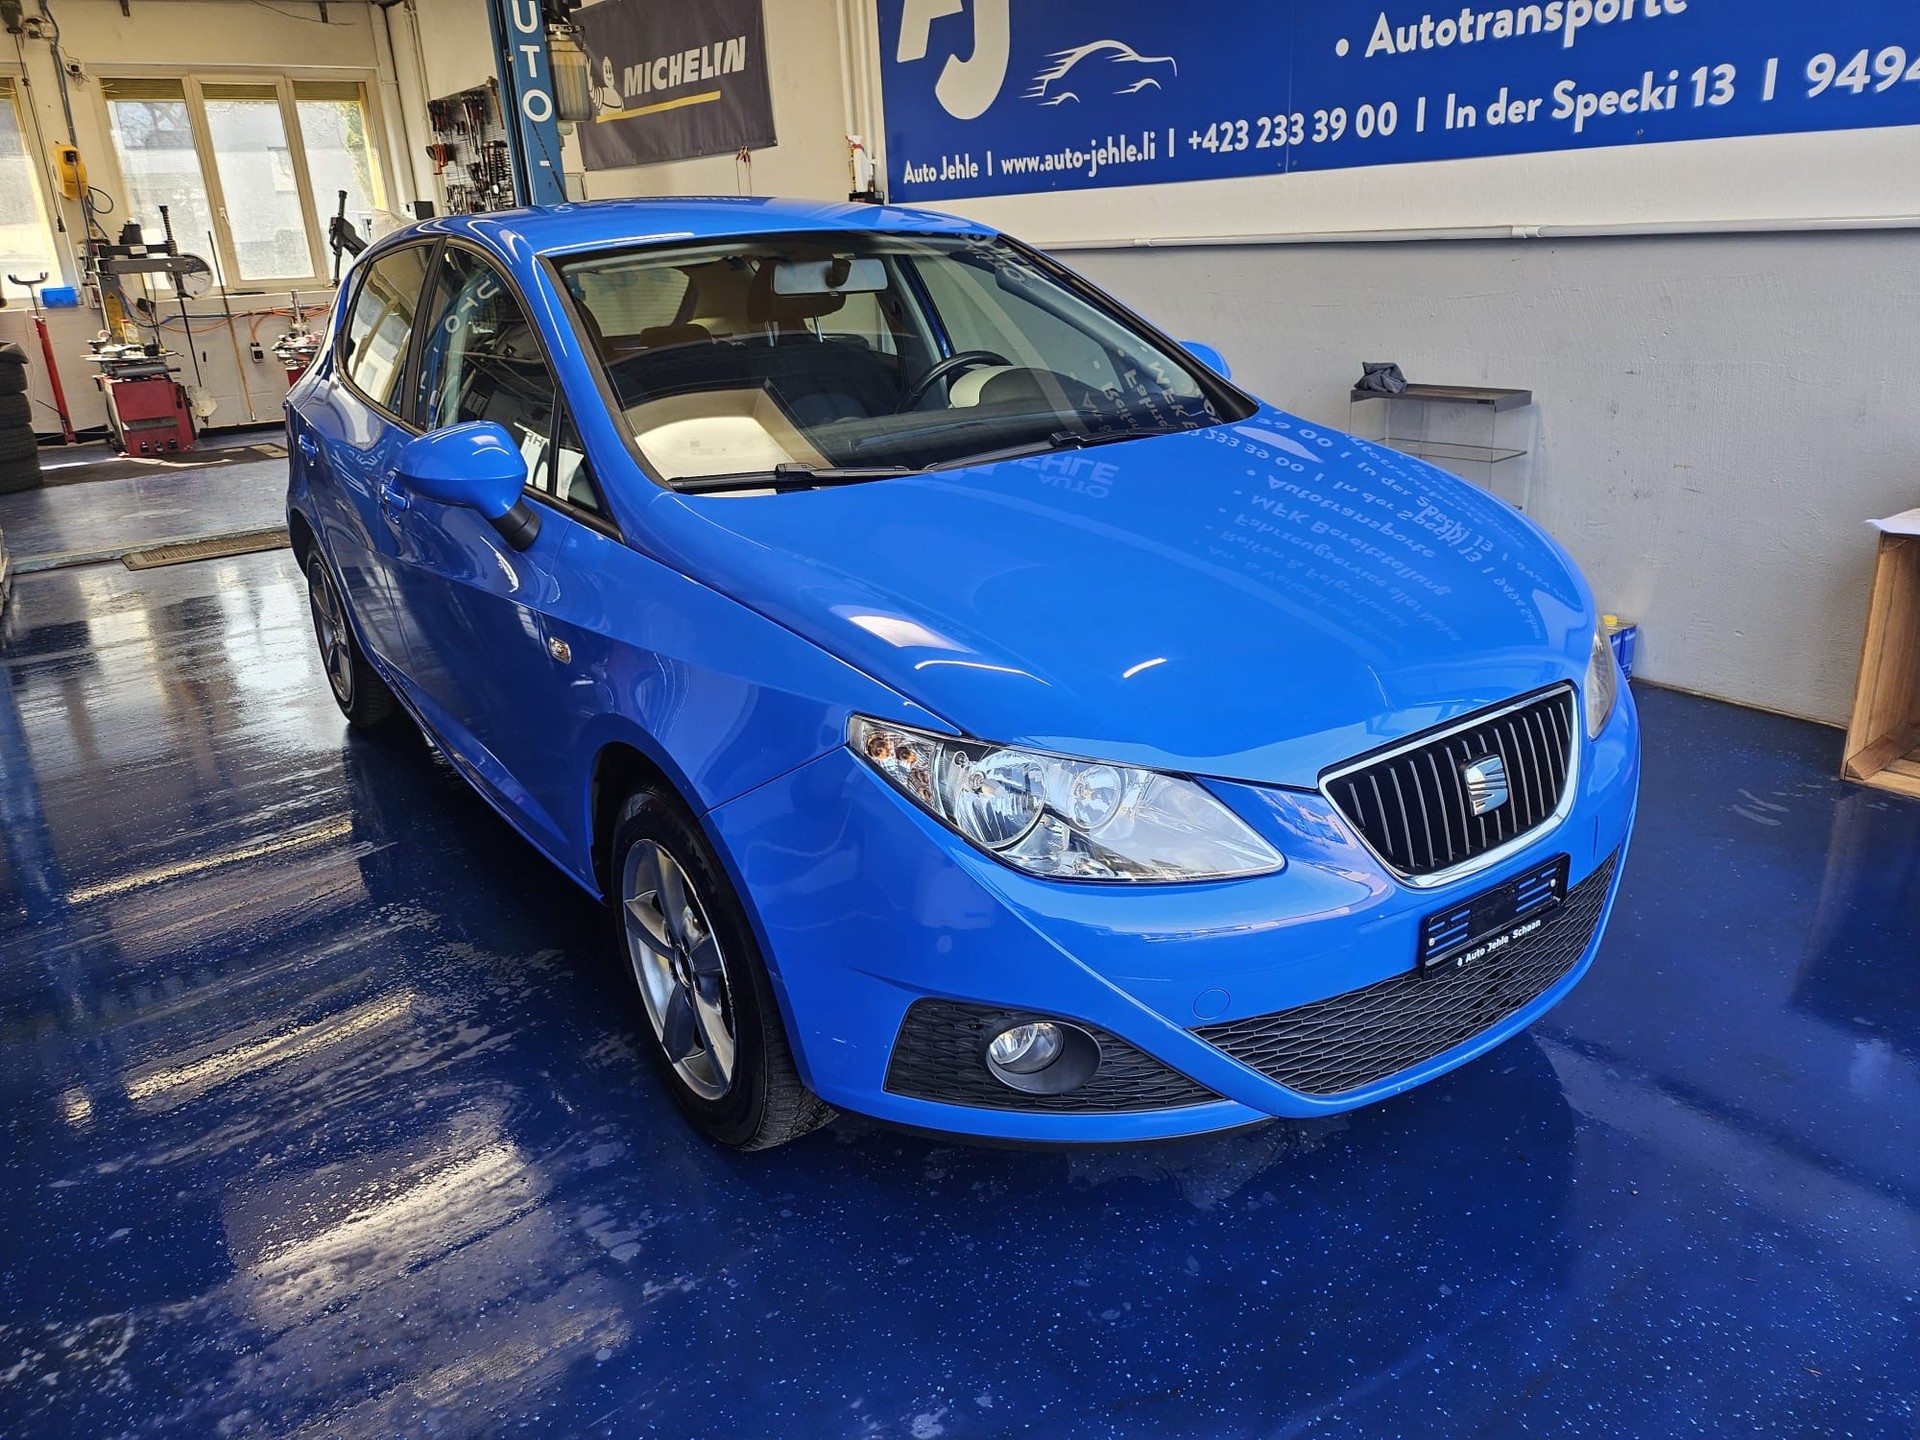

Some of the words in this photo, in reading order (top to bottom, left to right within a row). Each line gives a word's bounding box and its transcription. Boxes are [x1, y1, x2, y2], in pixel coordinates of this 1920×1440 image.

[623, 36, 746, 98] MICHELIN
[903, 160, 937, 184] Auto
[940, 153, 978, 181] Jehle
[1001, 131, 1156, 177] www.auto-jehle.li
[1188, 119, 1249, 153] +423
[1255, 112, 1305, 149] 233
[1312, 107, 1347, 143] 39
[1356, 101, 1397, 138] 00
[1445, 93, 1476, 130] In
[1486, 87, 1543, 126] der
[1551, 69, 1679, 133] Specki
[1691, 63, 1736, 107] 13
[1465, 947, 1486, 963] Auto
[1486, 935, 1509, 952] Jehle
[1512, 919, 1541, 939] Schaan
